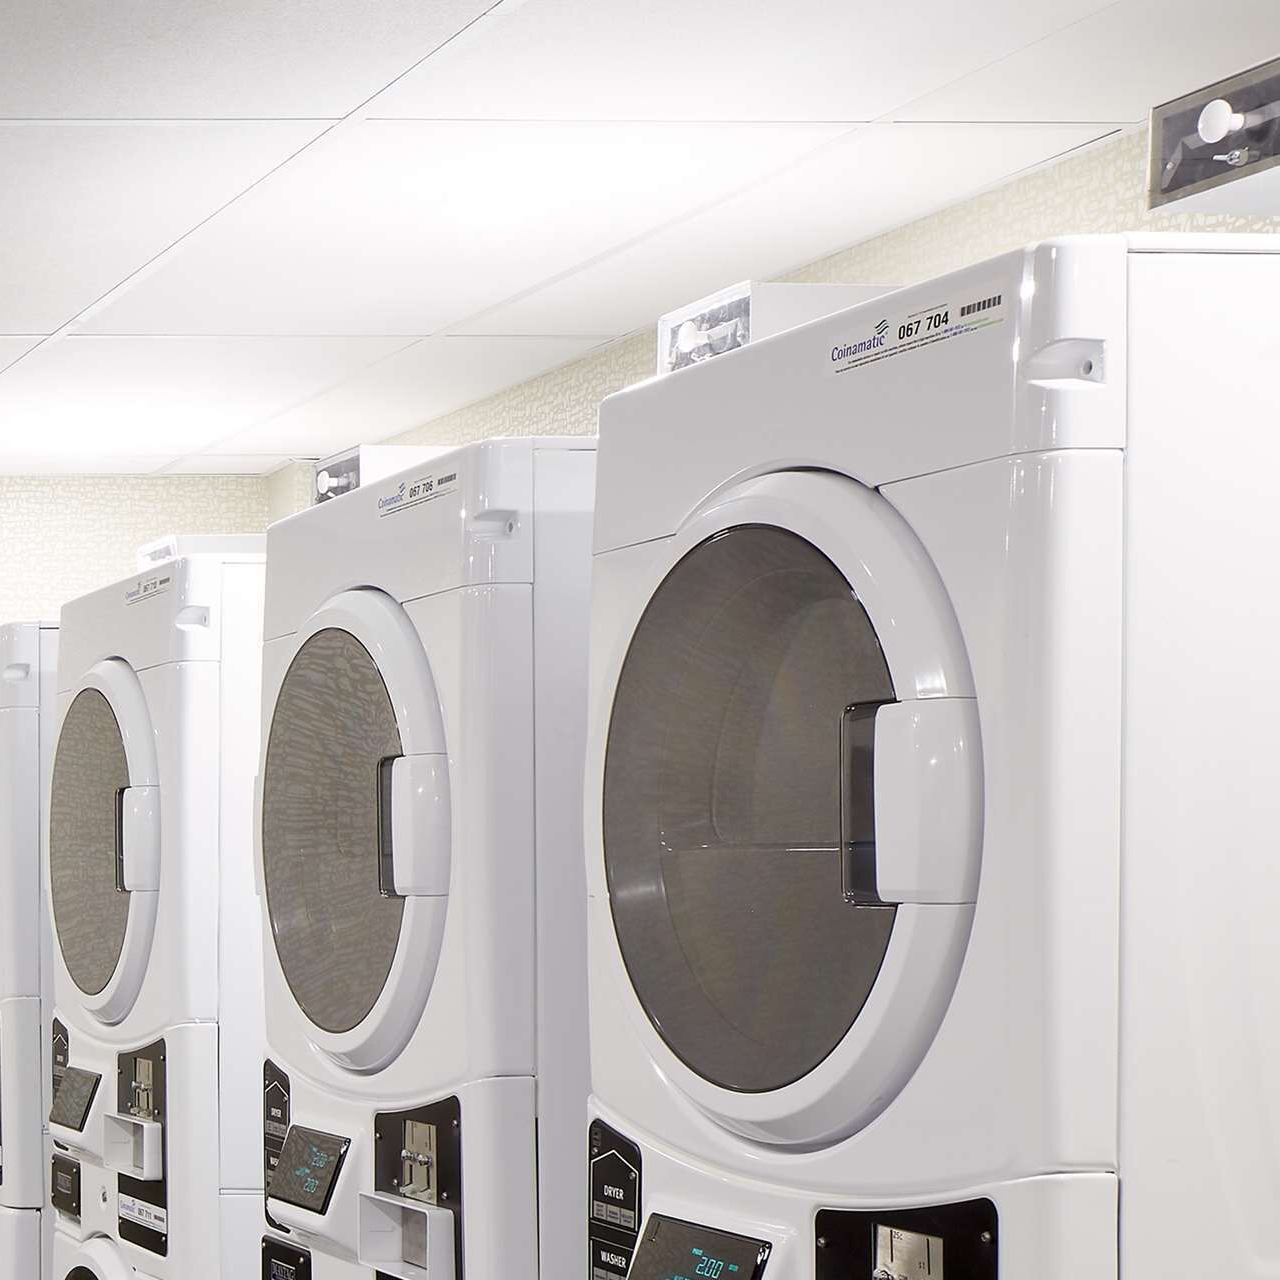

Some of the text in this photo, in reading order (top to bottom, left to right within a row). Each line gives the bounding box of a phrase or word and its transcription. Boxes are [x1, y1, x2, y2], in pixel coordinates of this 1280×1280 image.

[831, 311, 949, 362] Coinamatic 067 704
[603, 1185, 624, 1200] DRYER
[601, 1250, 627, 1269] WASHER
